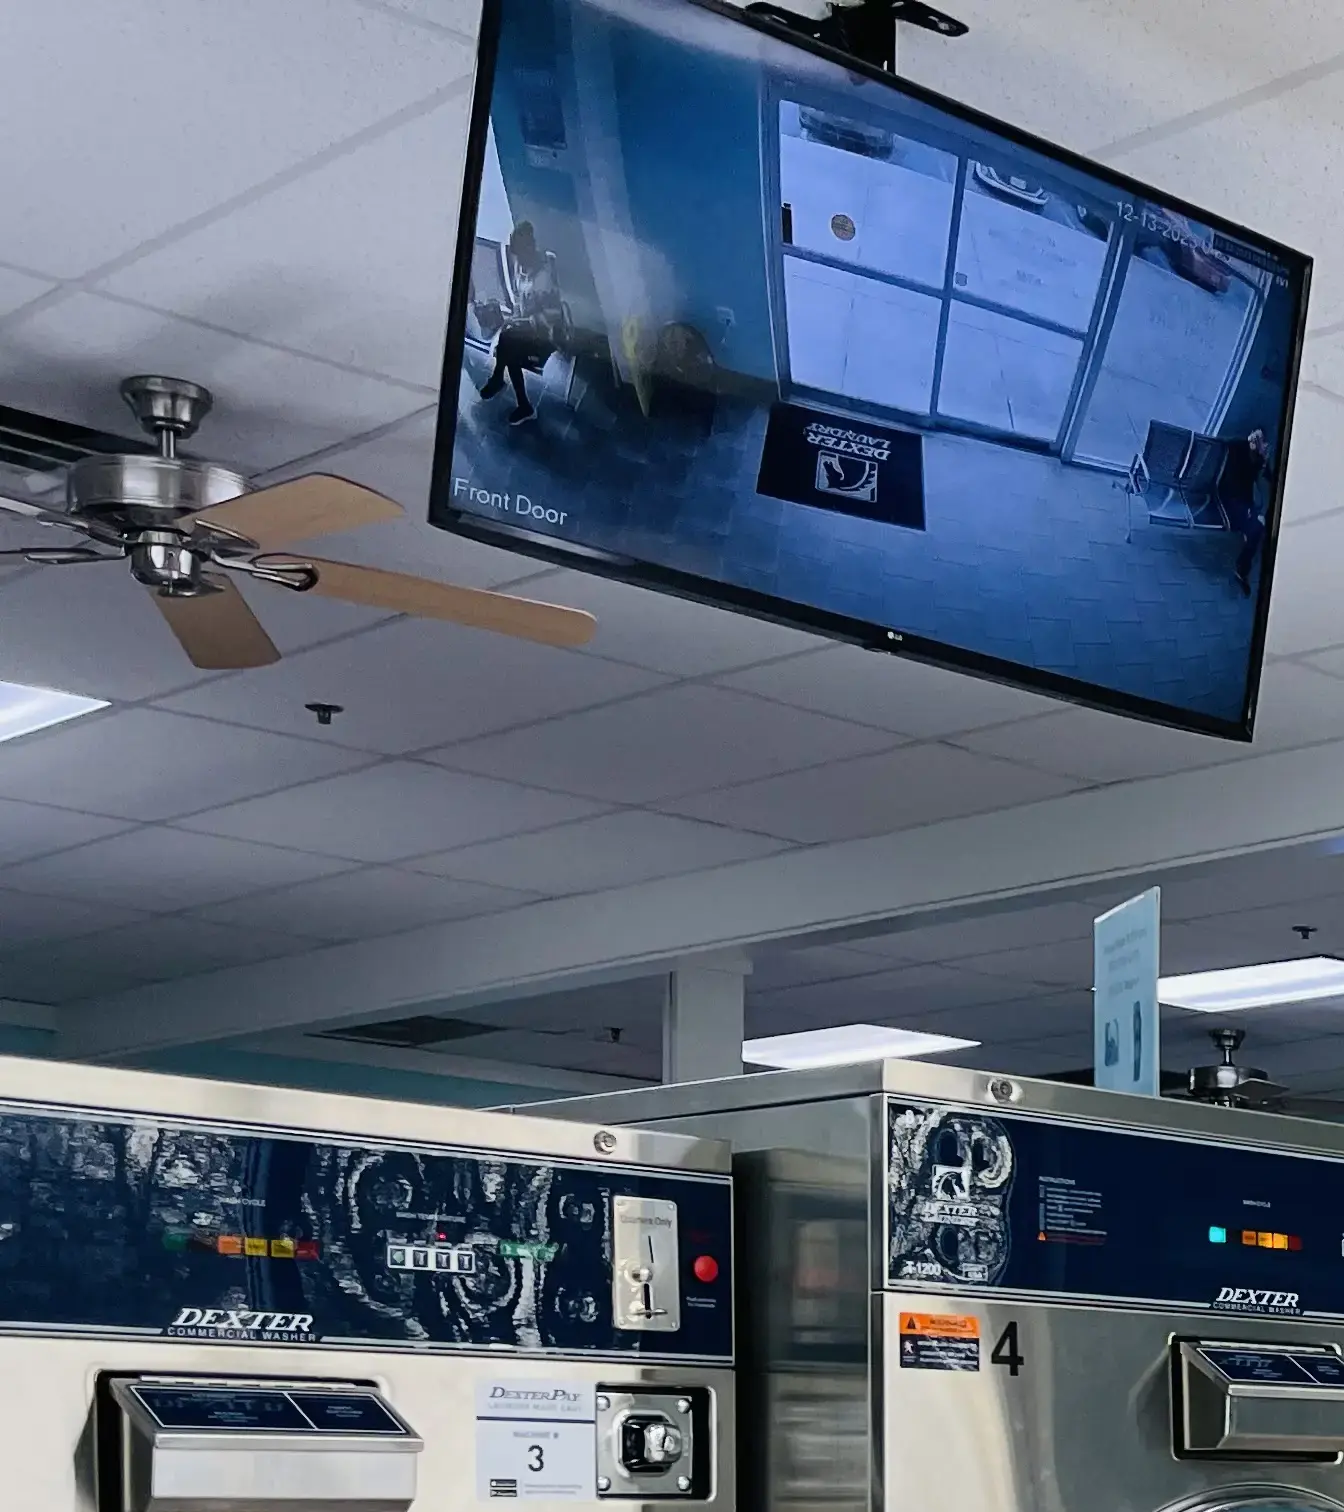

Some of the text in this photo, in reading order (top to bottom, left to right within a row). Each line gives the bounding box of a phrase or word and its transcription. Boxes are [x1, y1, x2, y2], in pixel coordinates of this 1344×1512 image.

[806, 432, 892, 461] DEXTER
[453, 477, 568, 526] Front Door
[1215, 1286, 1299, 1308] DEXTER
[171, 1307, 314, 1333] DEXTER
[167, 1326, 317, 1343] COMMERCIAL WASHER
[990, 1320, 1025, 1377] 4
[527, 1444, 545, 1472] 3
